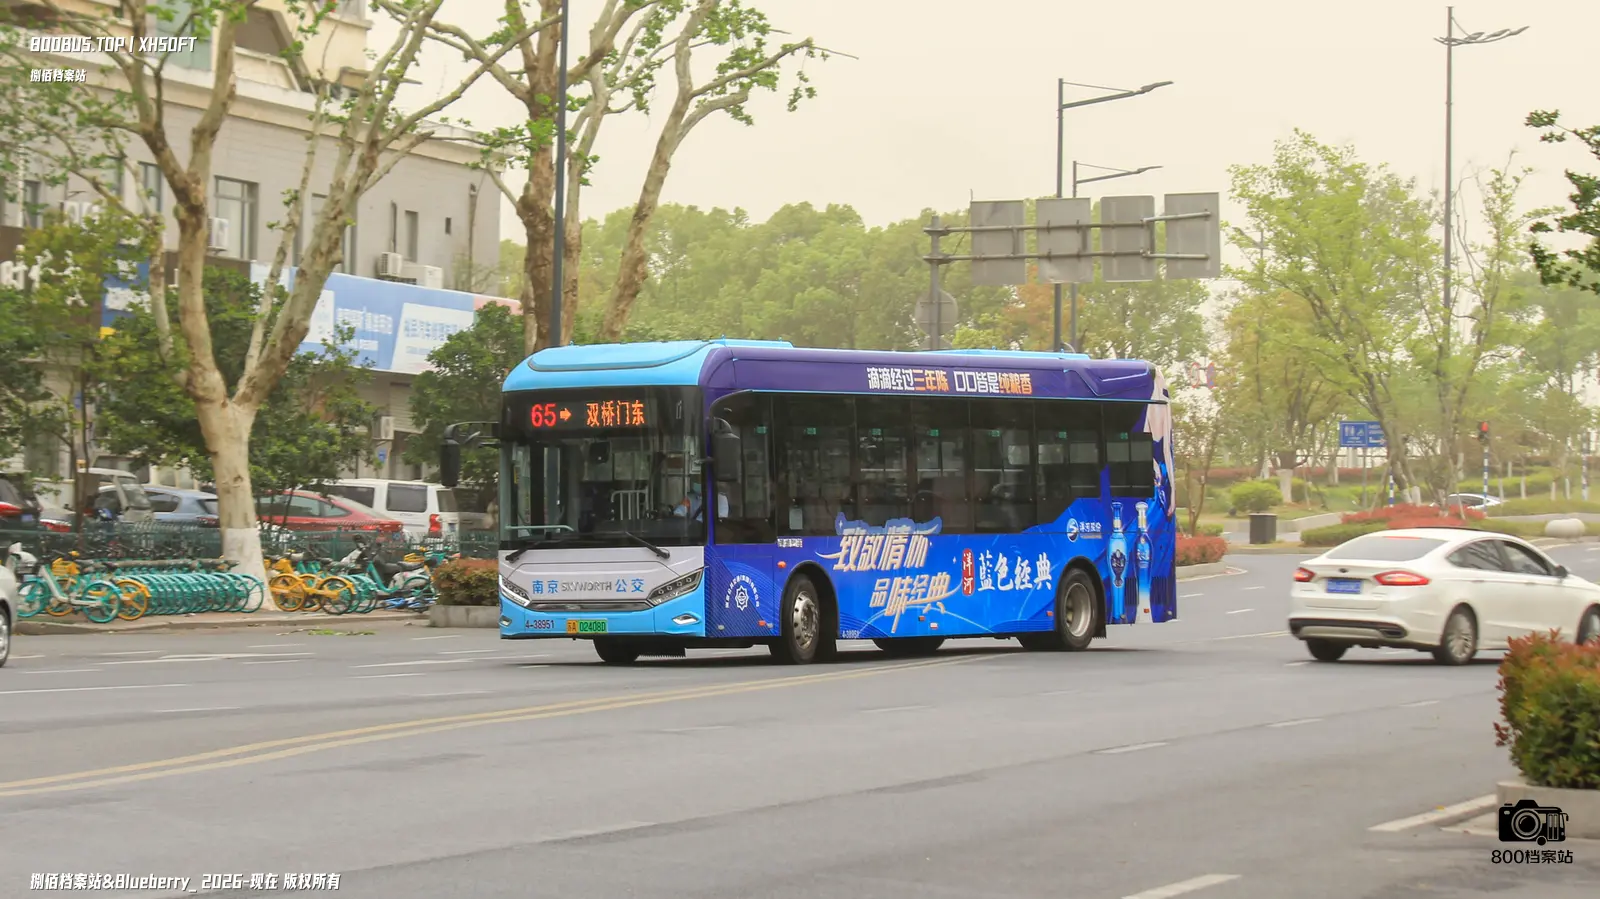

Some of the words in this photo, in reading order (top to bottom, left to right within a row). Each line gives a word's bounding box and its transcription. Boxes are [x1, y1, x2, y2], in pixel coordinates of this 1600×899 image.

[866, 367, 950, 392] 滴滴经过三年陈
[531, 403, 558, 428] 65
[586, 400, 646, 428] 双桥门东
[532, 579, 559, 594] 南京
[561, 581, 613, 593] SKYWORTH
[615, 578, 645, 593] 公交
[962, 551, 975, 595] 洋河
[868, 570, 957, 634] 品味经典
[525, 619, 555, 630] 4-38951
